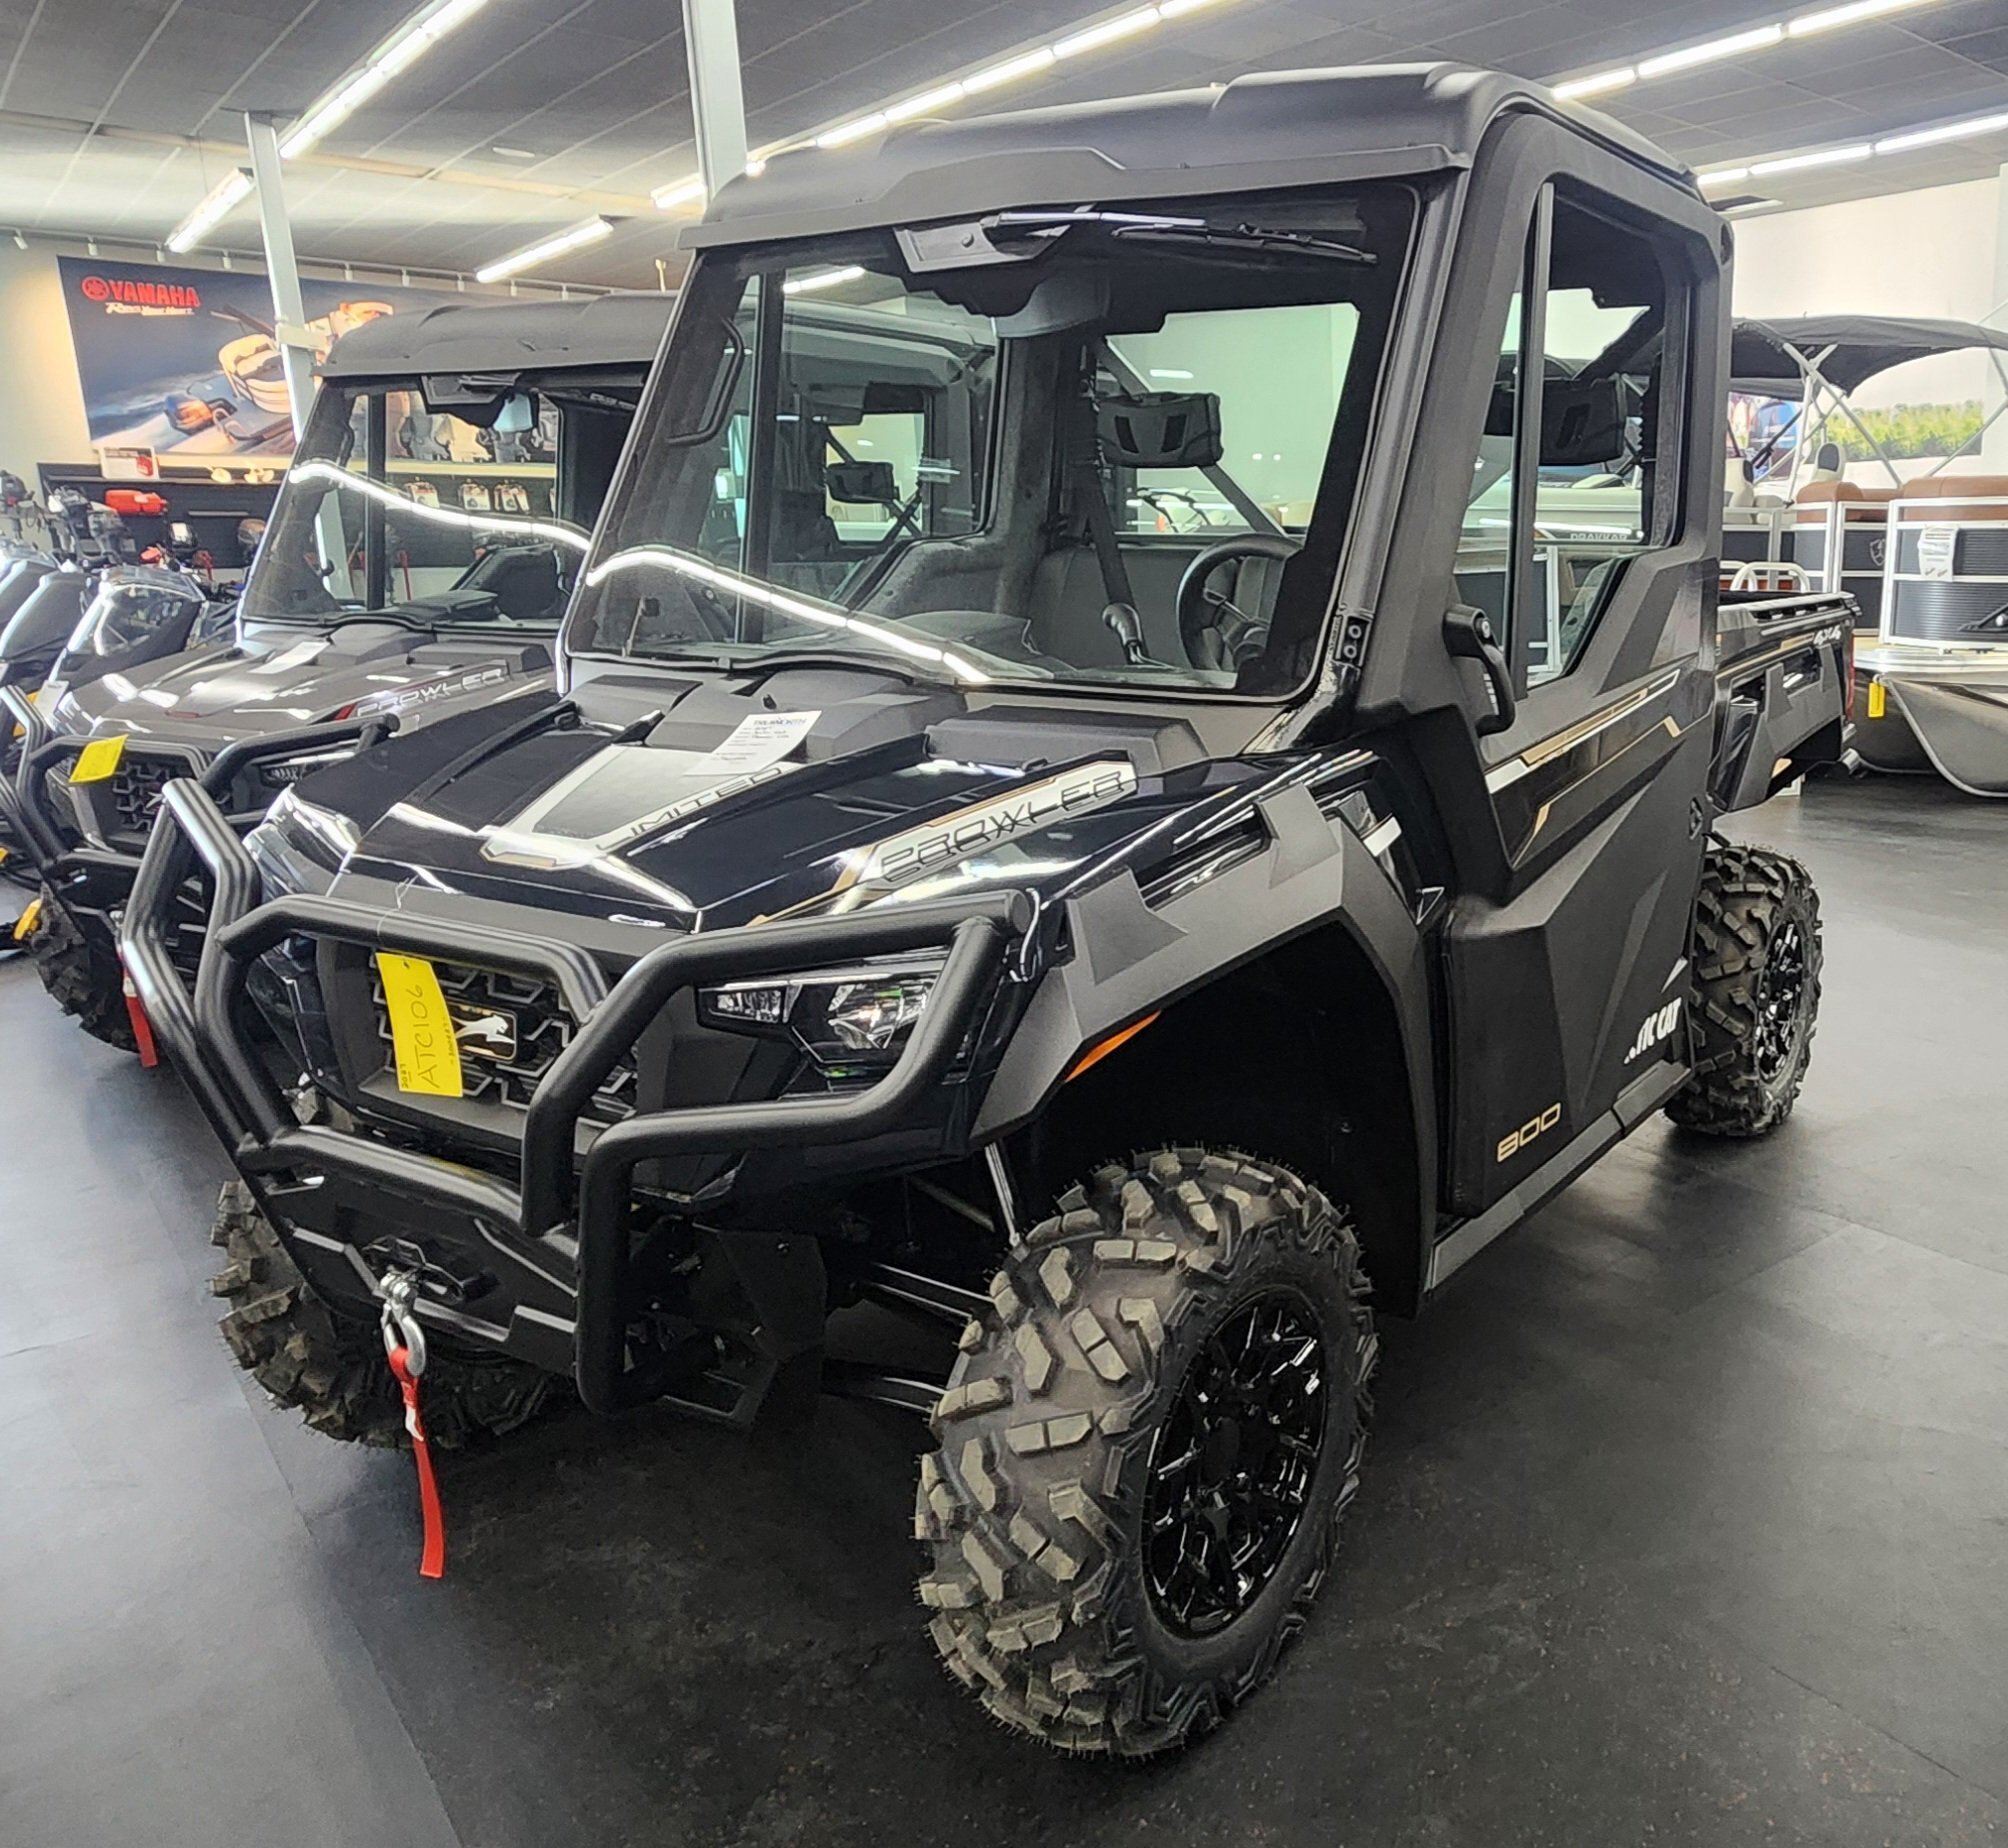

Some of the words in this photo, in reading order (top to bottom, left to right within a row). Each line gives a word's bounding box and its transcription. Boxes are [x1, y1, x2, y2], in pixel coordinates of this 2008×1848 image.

[108, 279, 200, 308] YAMAHA
[596, 767, 782, 851] LIMITED
[881, 770, 1125, 883] PROWLER
[406, 984, 440, 1089] ATC106
[1497, 1102, 1562, 1162] 800
